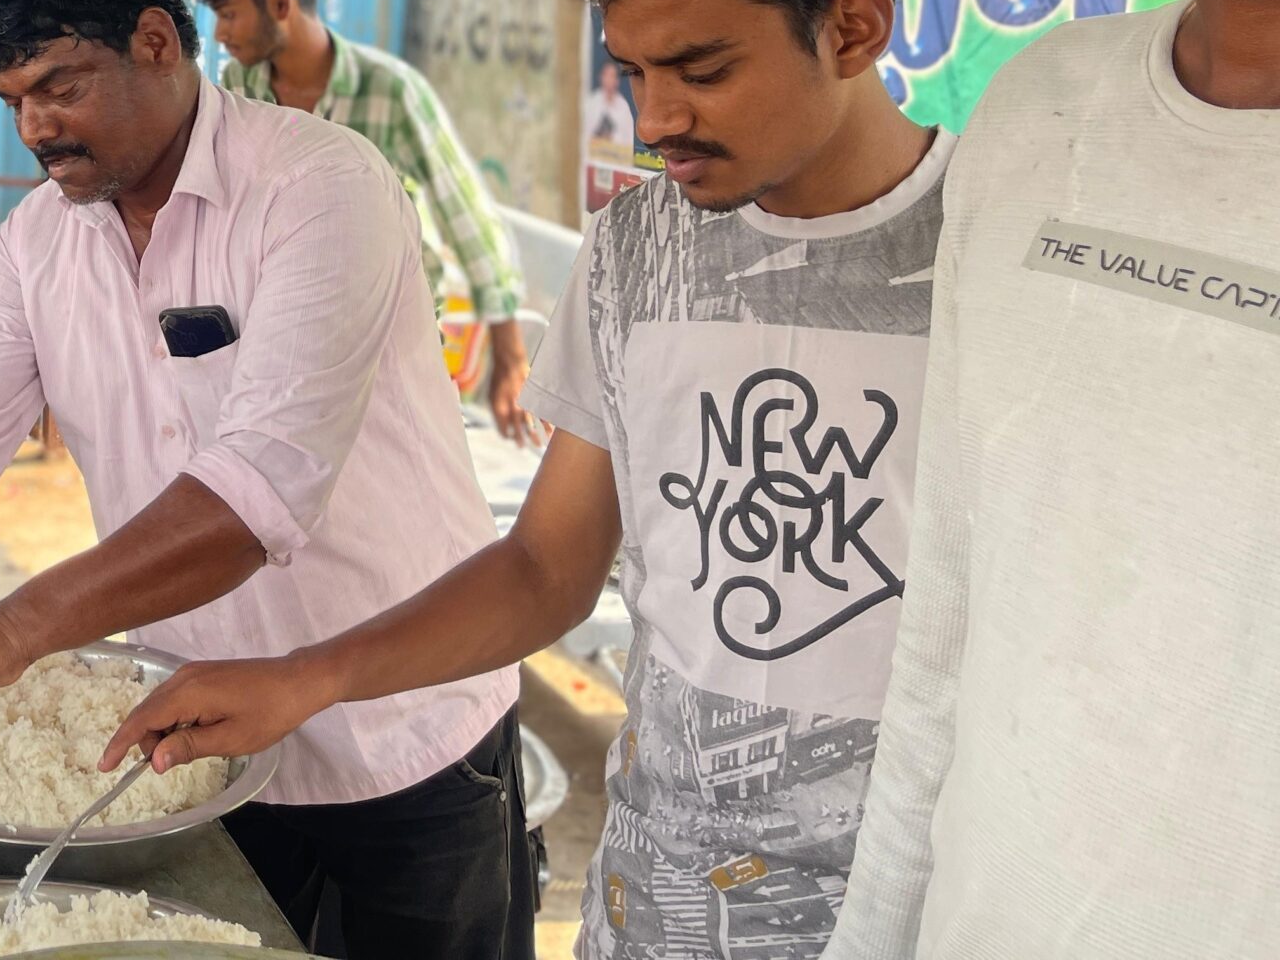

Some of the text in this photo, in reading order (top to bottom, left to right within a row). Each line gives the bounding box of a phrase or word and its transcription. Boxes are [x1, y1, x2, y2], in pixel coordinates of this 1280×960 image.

[1040, 237, 1092, 266] THE
[1100, 248, 1196, 292] VALUE
[699, 368, 898, 480] NEW
[659, 471, 905, 596] YORK
